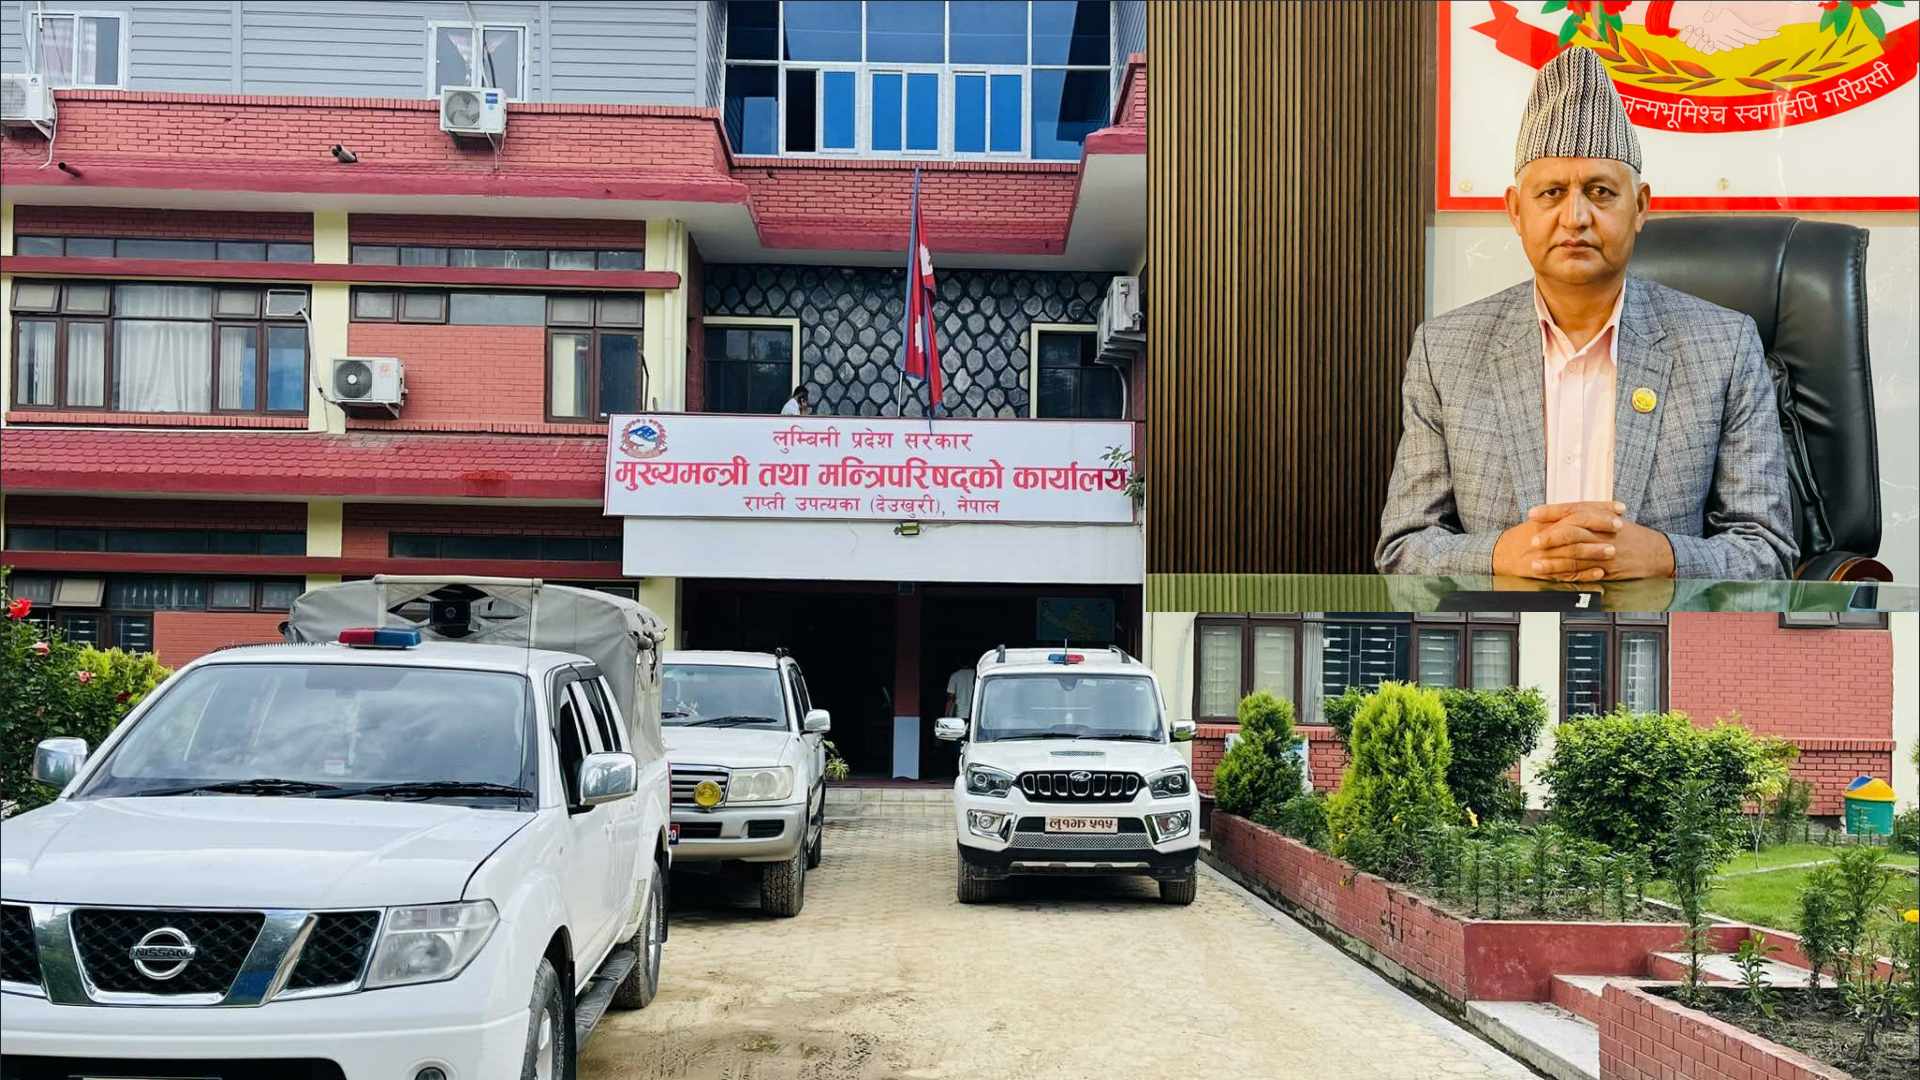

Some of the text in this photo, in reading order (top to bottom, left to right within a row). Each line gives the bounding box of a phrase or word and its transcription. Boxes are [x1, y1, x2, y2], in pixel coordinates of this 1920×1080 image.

[1823, 60, 1895, 107] गरीयसी
[772, 425, 972, 454] लुम्बिनी प्रदेश सरकार
[615, 456, 1128, 493] मुख्यमन्त्री तथा मन्त्रिपरिषद्को कार्यालय
[743, 491, 786, 512] राप्ती
[795, 495, 861, 512] उपत्यका
[957, 495, 1000, 514] नेपाल
[135, 948, 188, 959] NISSAN
